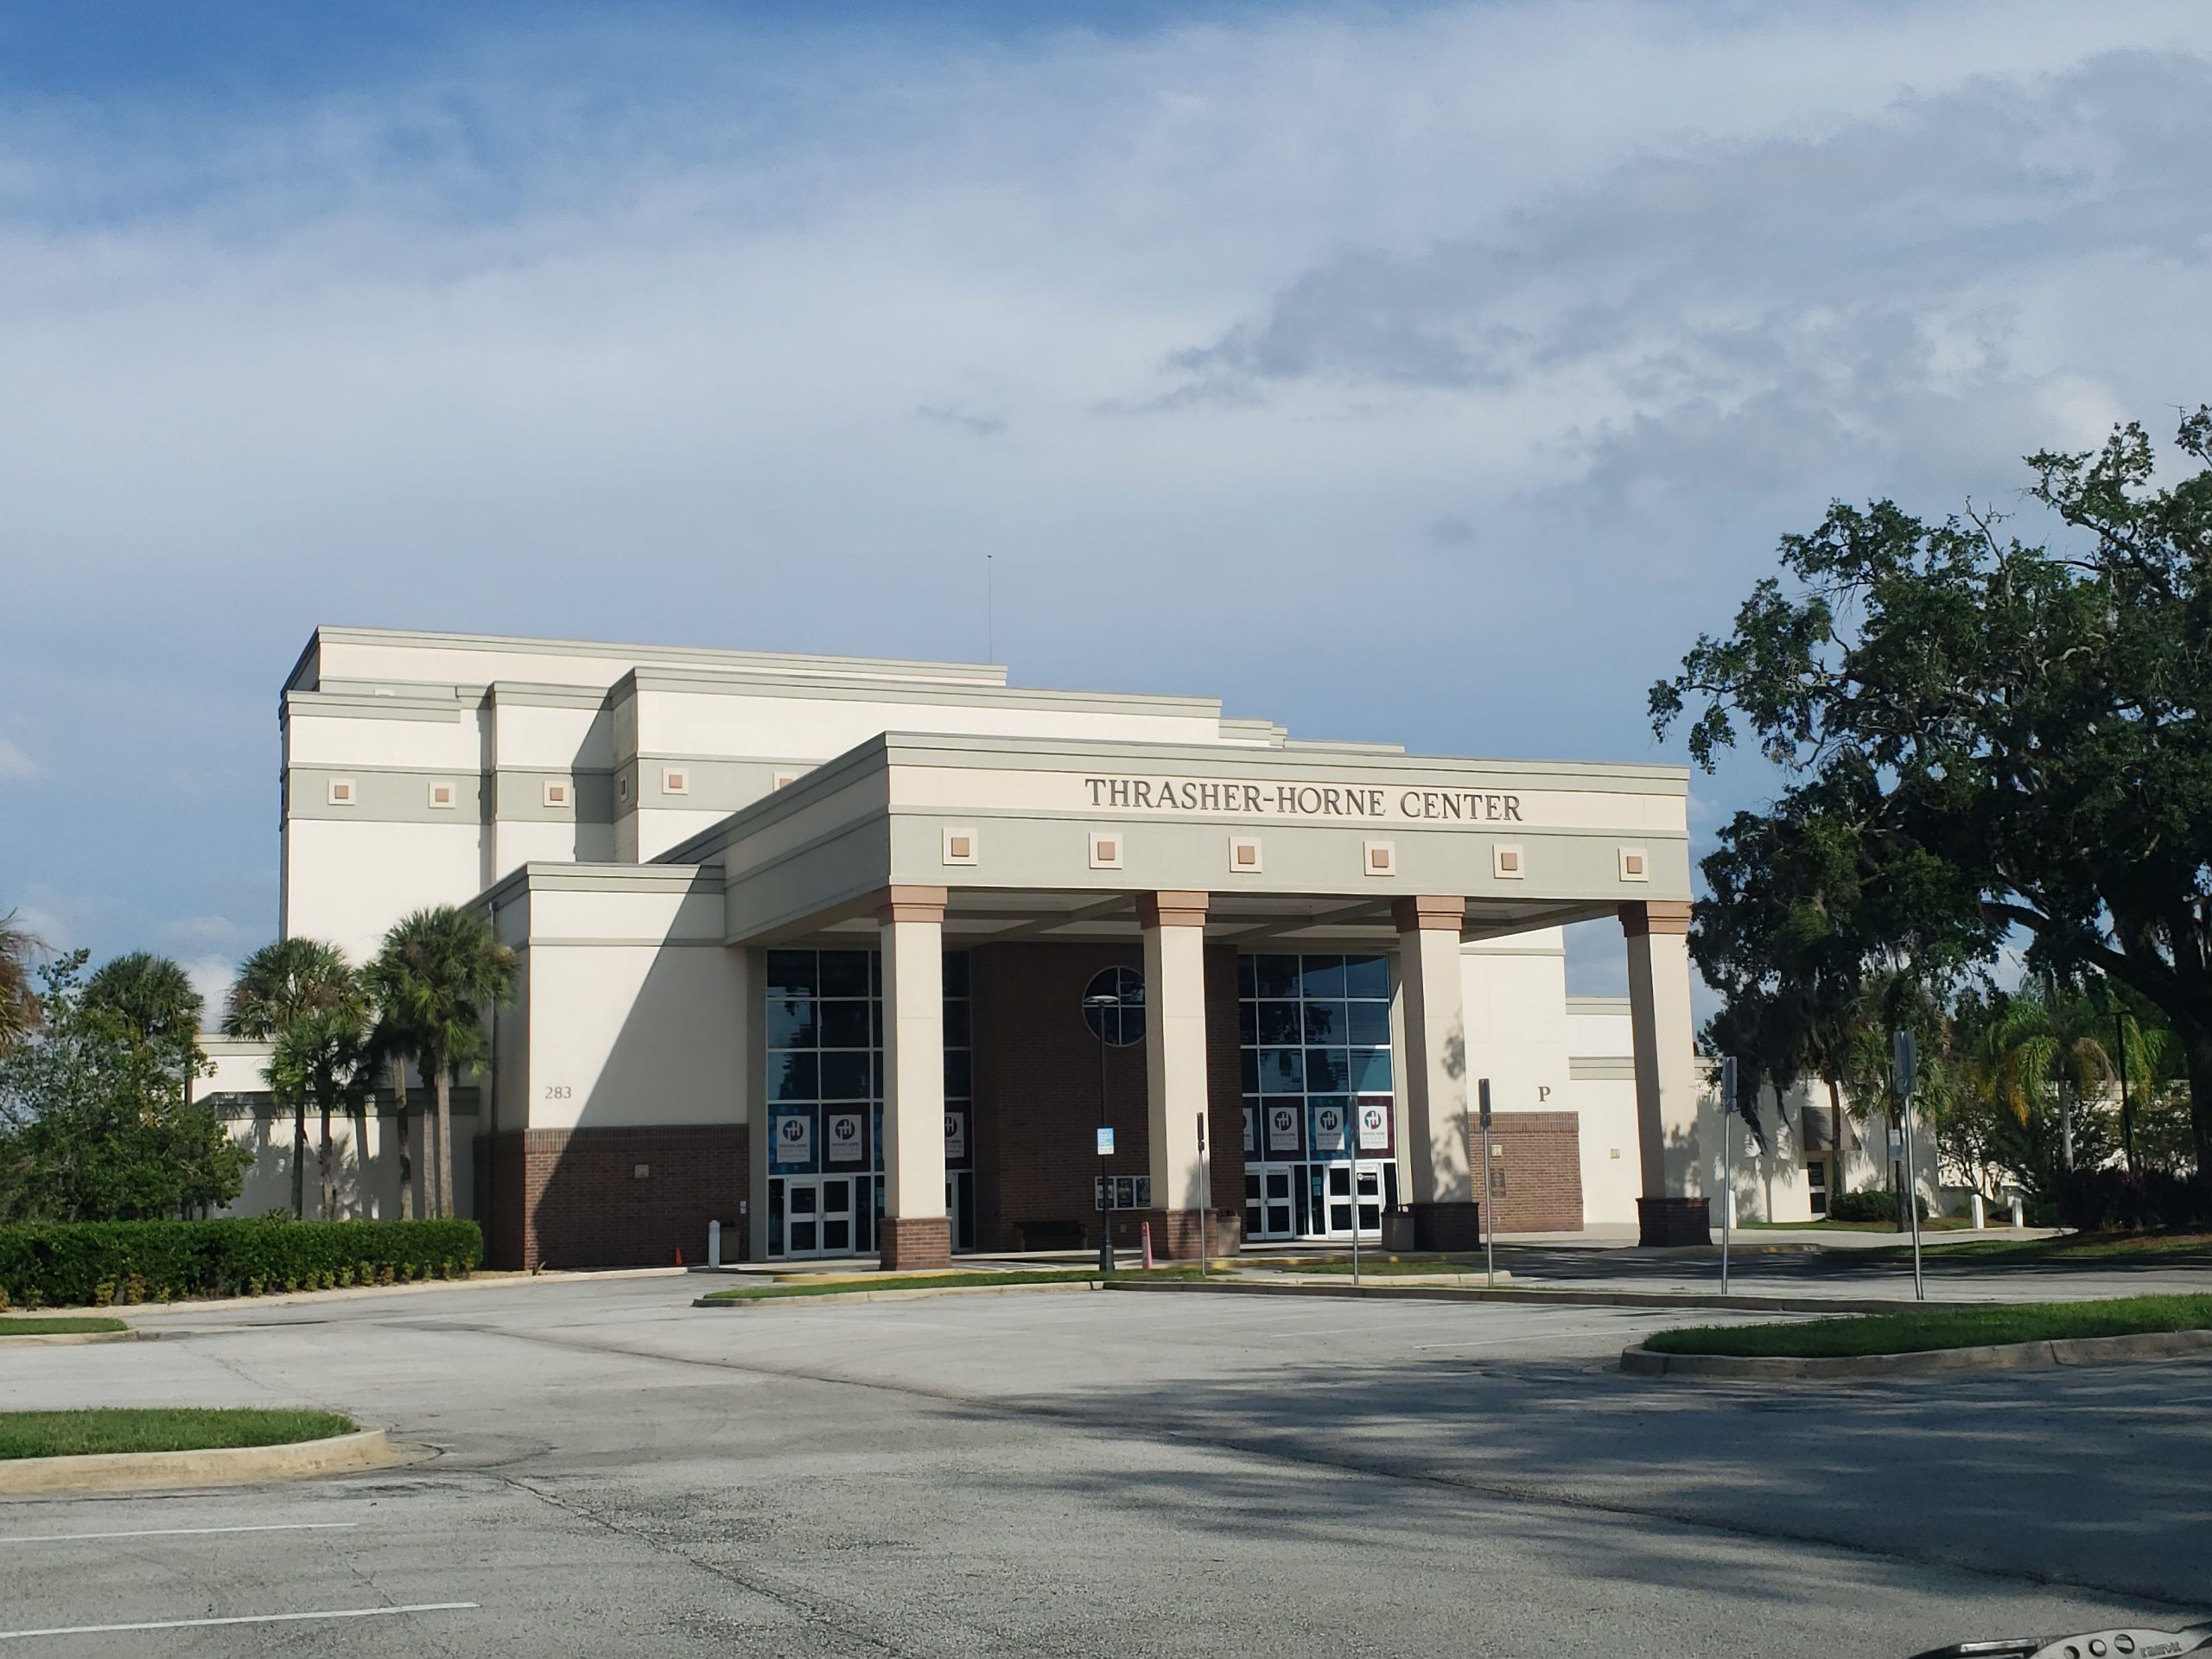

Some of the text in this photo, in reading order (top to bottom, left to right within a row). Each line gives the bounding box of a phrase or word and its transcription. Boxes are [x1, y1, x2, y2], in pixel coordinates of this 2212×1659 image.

[1085, 779, 1523, 822] THRASHER-HORNE CENTER
[545, 1085, 571, 1099] 283
[1538, 1086, 1551, 1102] P
